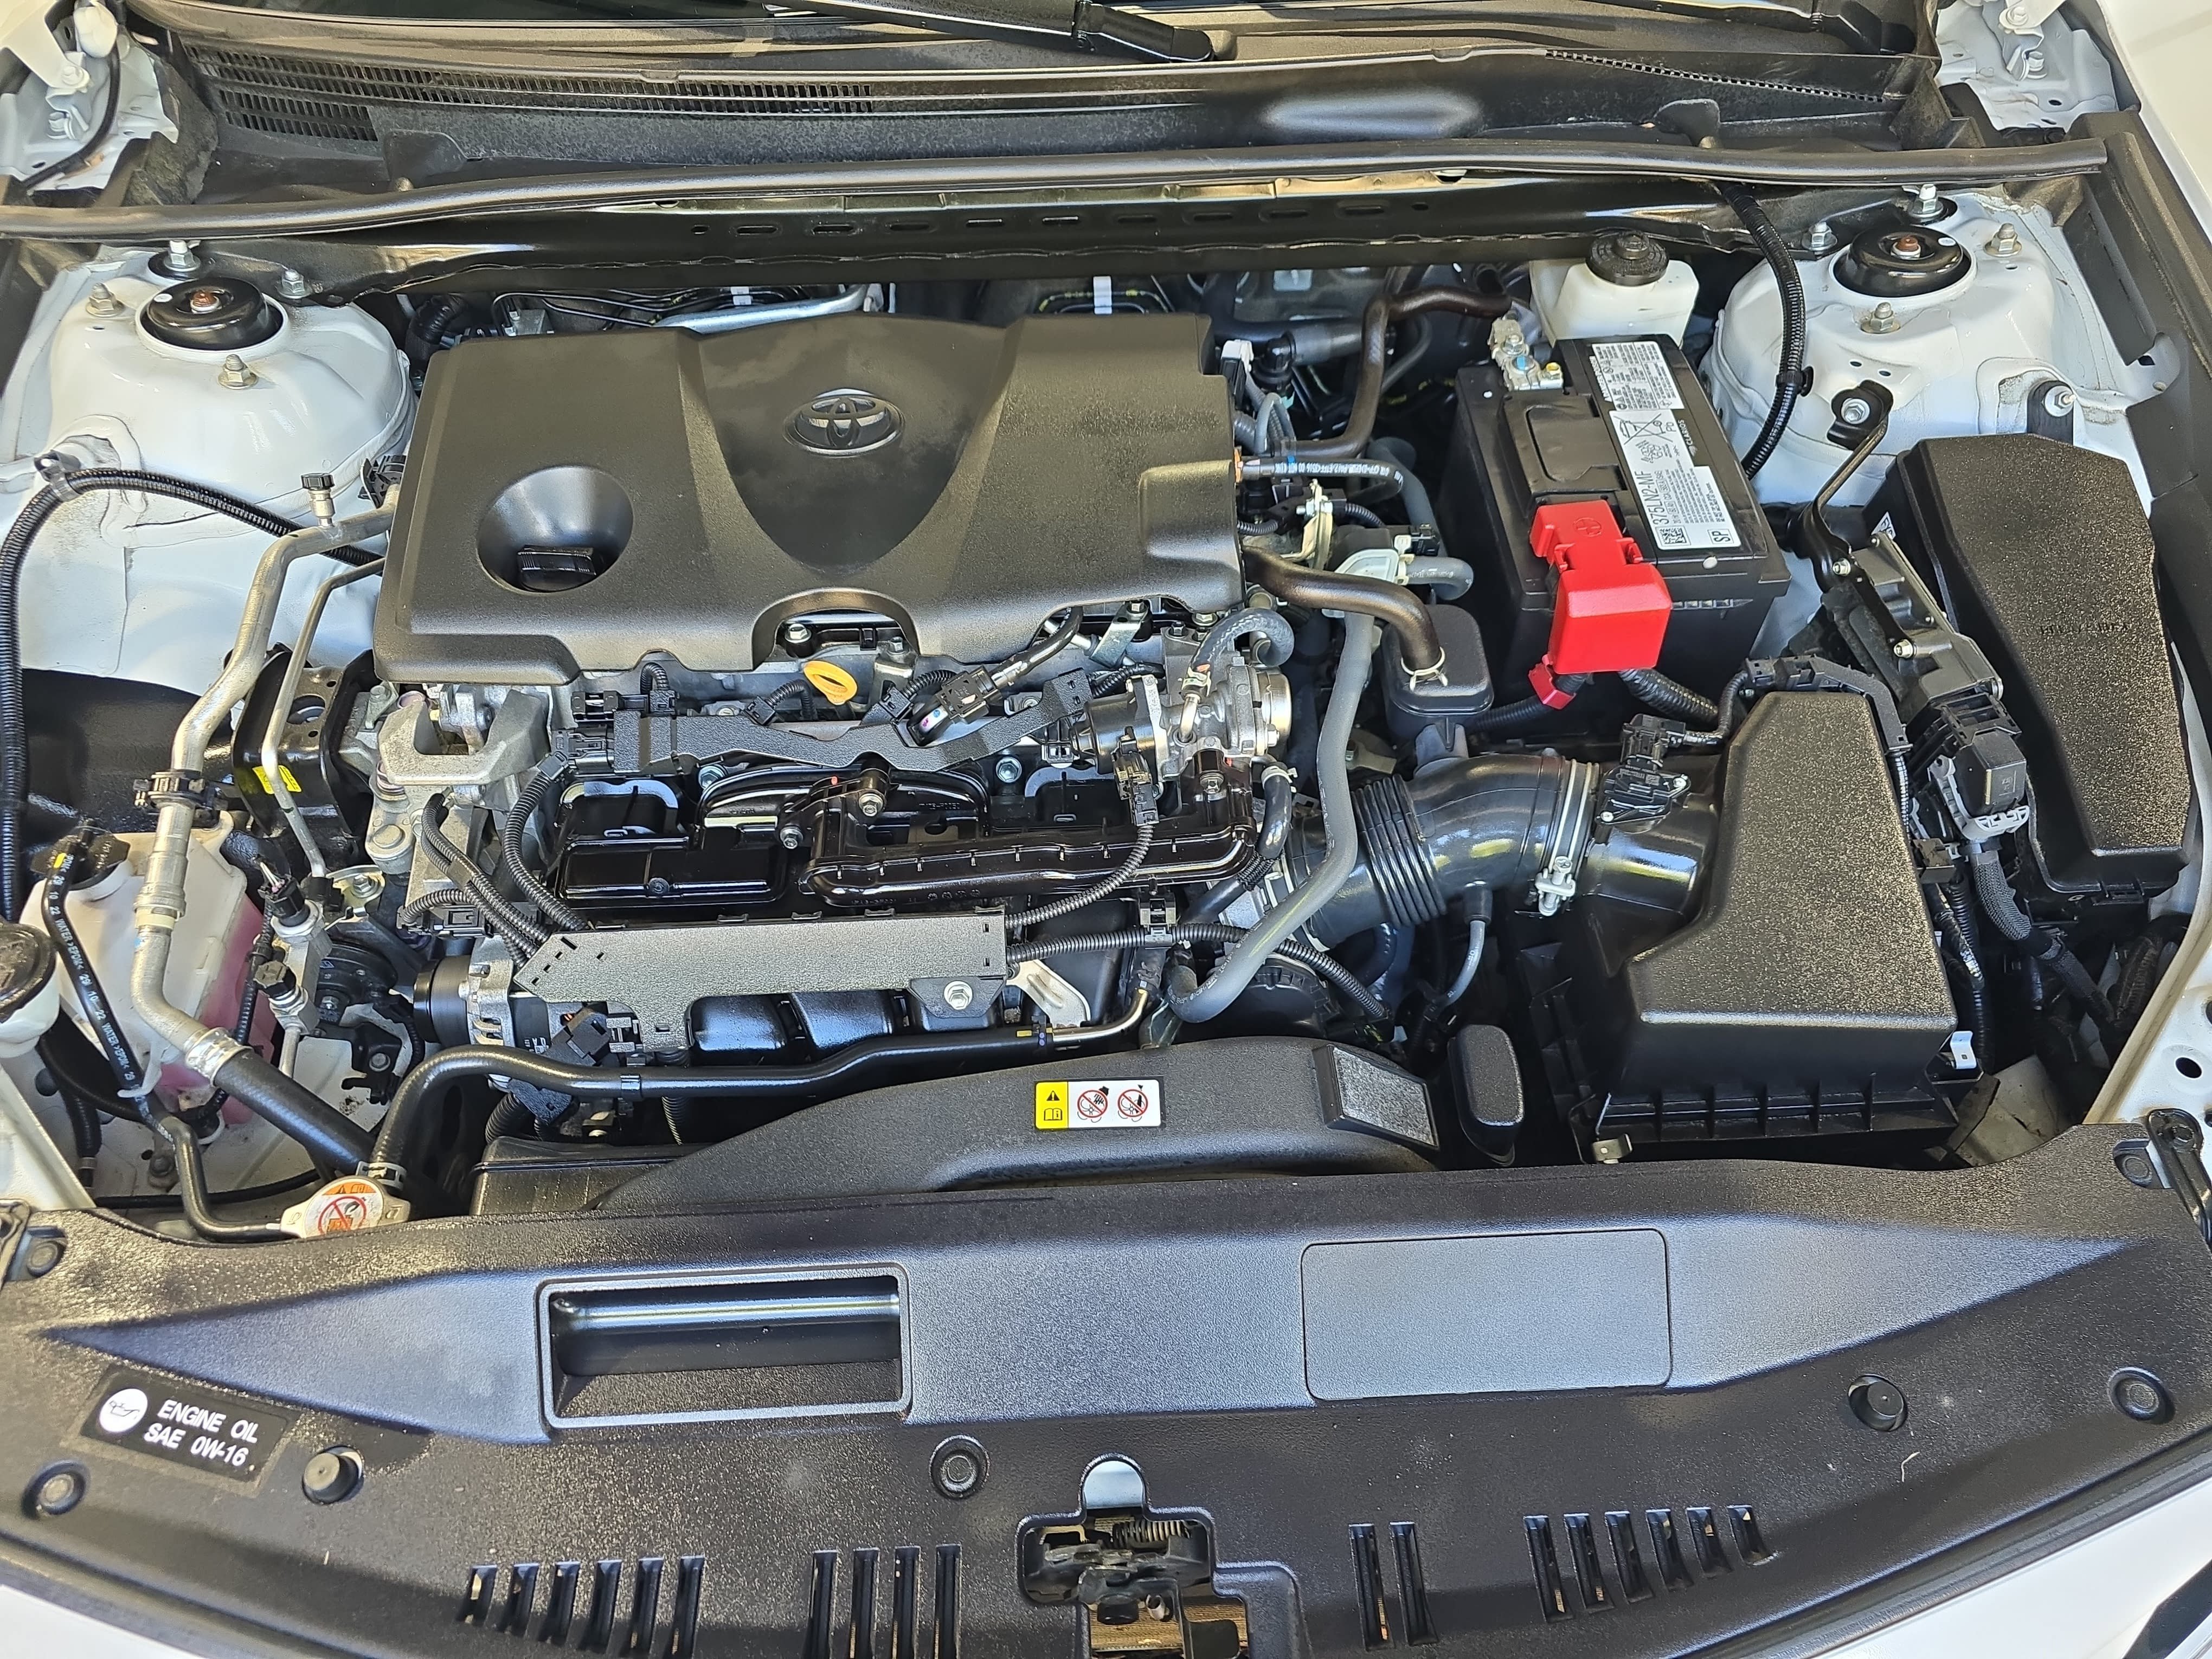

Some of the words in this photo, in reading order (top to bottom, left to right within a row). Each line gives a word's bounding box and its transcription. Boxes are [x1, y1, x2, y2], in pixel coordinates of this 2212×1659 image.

[1678, 419, 1693, 446] CLARIOS
[1634, 471, 1670, 525] 375LN2-MF
[1711, 531, 1731, 543] SP
[49, 906, 61, 915] 22
[94, 1009, 106, 1020] 22
[157, 1399, 227, 1432] ENGINE
[230, 1419, 259, 1443] OIL
[144, 1423, 186, 1449] SAE
[190, 1436, 249, 1466] 0W-16
